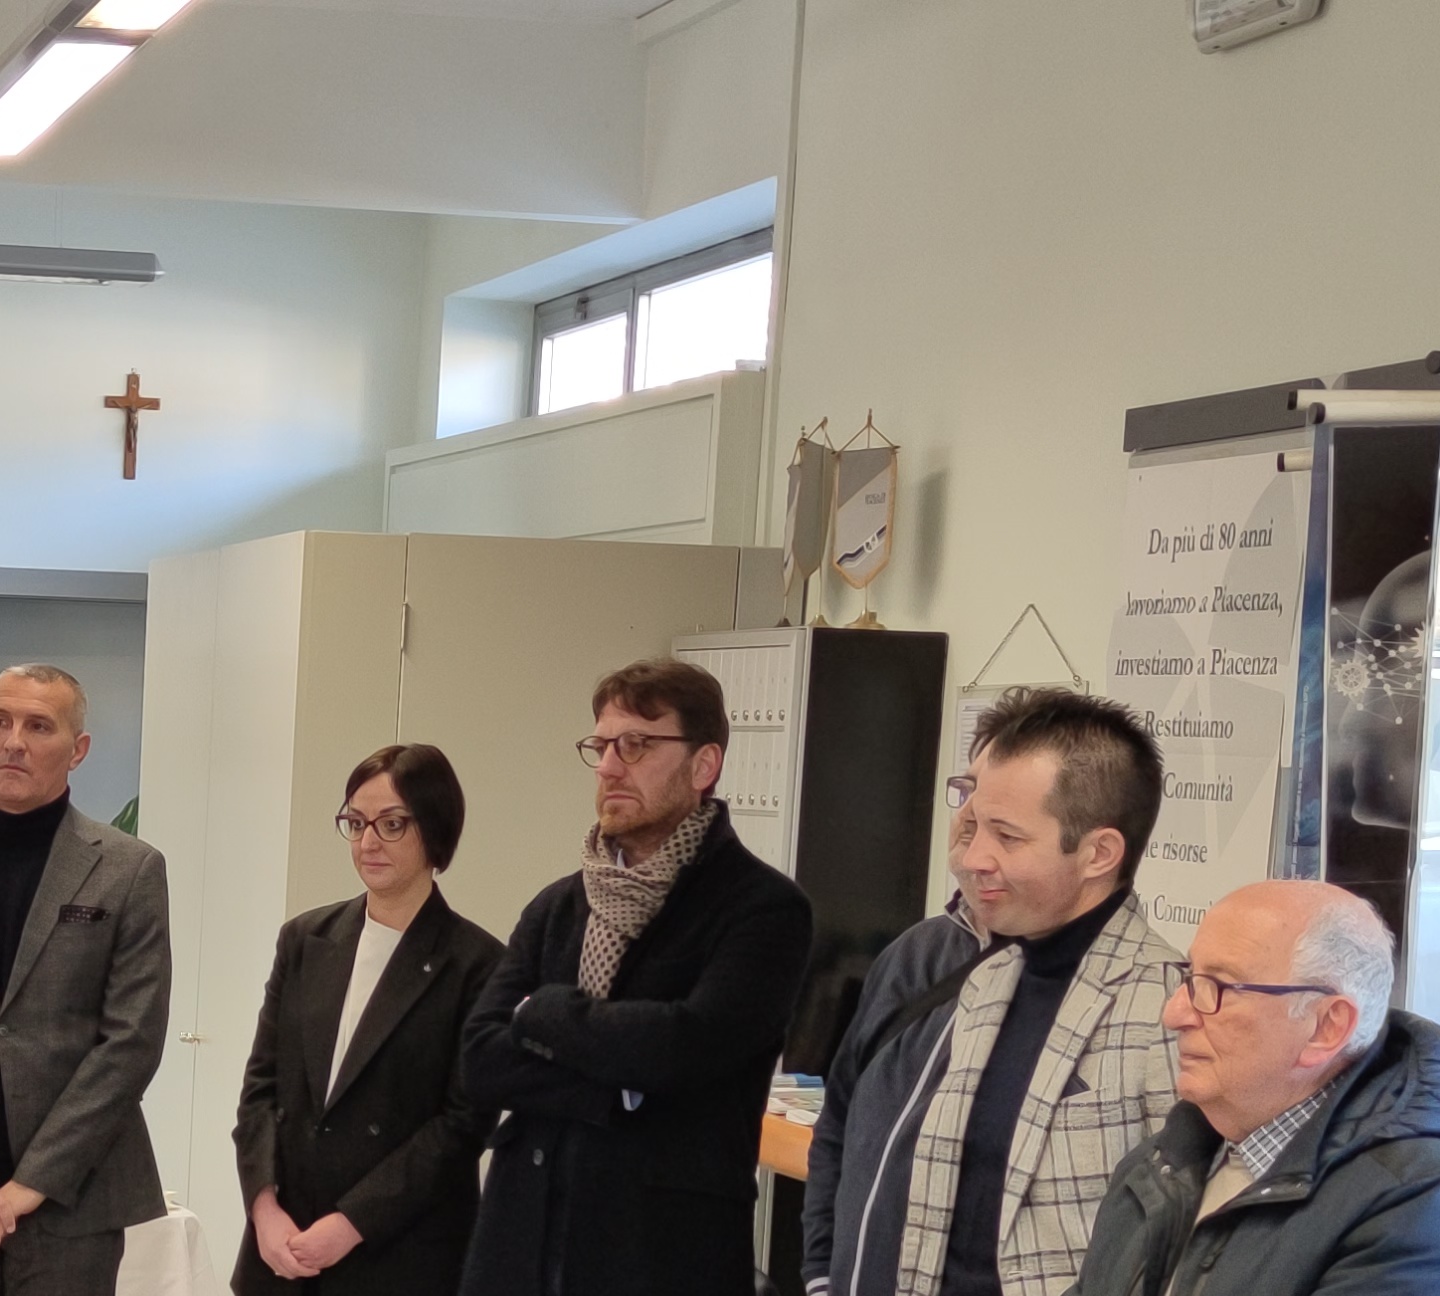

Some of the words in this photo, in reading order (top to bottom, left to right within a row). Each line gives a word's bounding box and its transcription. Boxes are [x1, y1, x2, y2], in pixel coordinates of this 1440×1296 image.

[1147, 528, 1168, 555] Da
[1171, 526, 1195, 563] più
[1200, 523, 1214, 551] di
[1218, 522, 1236, 549] 80
[1239, 518, 1274, 548] anni
[1126, 589, 1195, 616] lavoriamo
[1199, 598, 1208, 614] a
[1211, 586, 1282, 617] Piacenza,
[1115, 650, 1193, 676] investiamo
[1197, 657, 1205, 675] a
[1210, 648, 1278, 676] Piacenza
[1144, 710, 1234, 739] Restituiamo
[1163, 772, 1233, 802] Comunità
[1162, 833, 1208, 863] risorse
[1154, 894, 1214, 926] Comun
